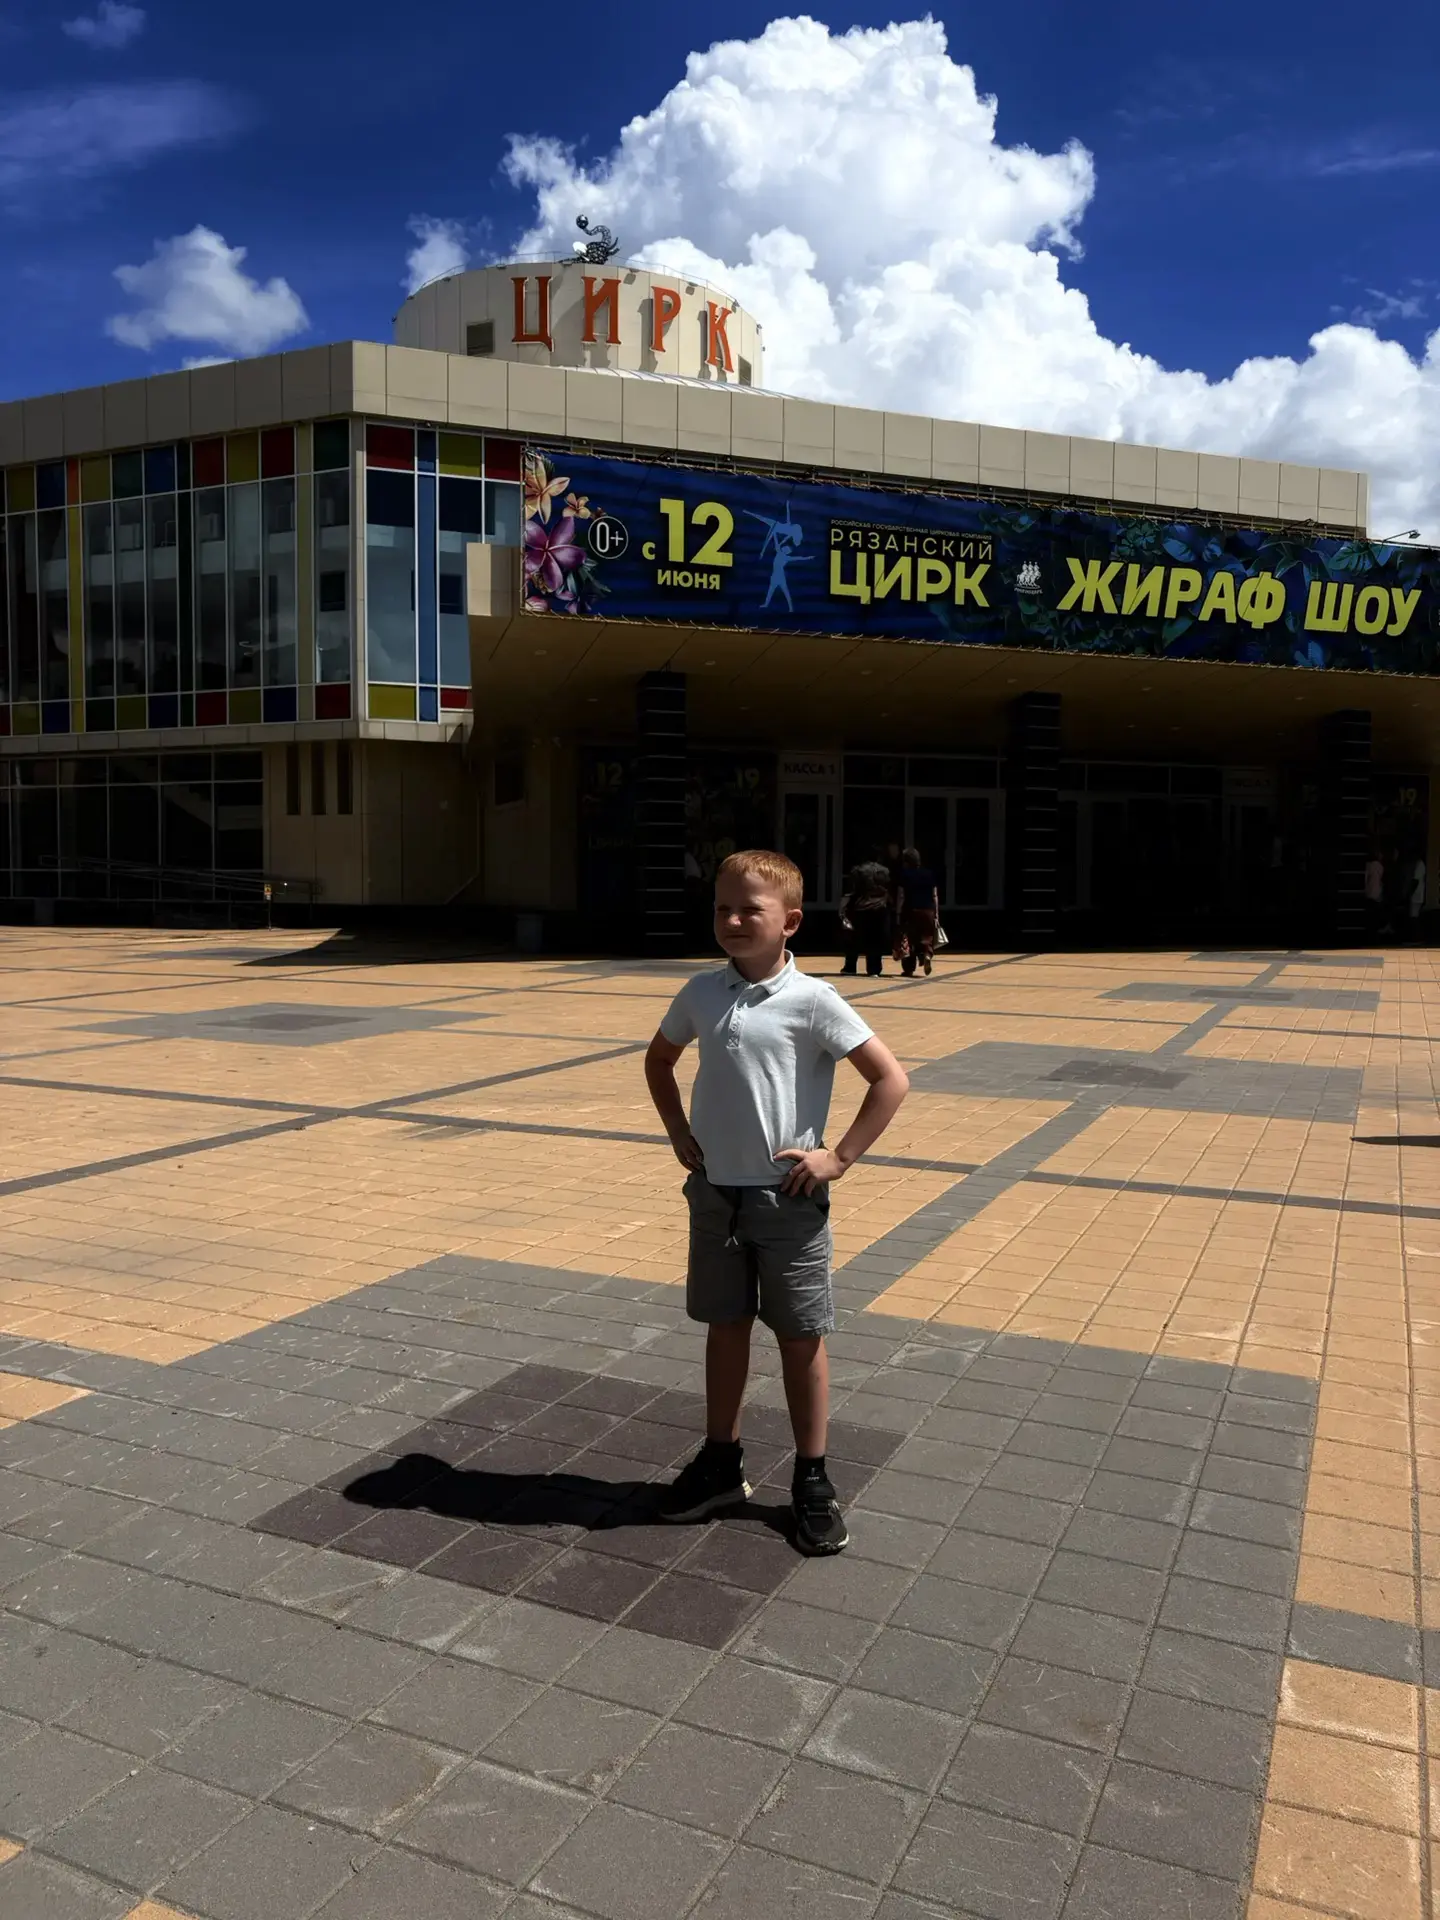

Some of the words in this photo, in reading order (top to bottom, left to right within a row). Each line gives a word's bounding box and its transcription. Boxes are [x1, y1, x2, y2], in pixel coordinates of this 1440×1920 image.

[511, 275, 735, 373] ЦИРК
[595, 521, 625, 554] 0+
[659, 498, 734, 568] 12
[830, 528, 993, 561] РЯЗАНСКИЙ
[829, 548, 992, 608] ЦИРК
[1056, 557, 1288, 630] ЖИРАФ
[1303, 580, 1423, 638] ШОУ
[595, 762, 623, 786] 12
[735, 767, 760, 789] 19
[1398, 787, 1418, 806] 19
